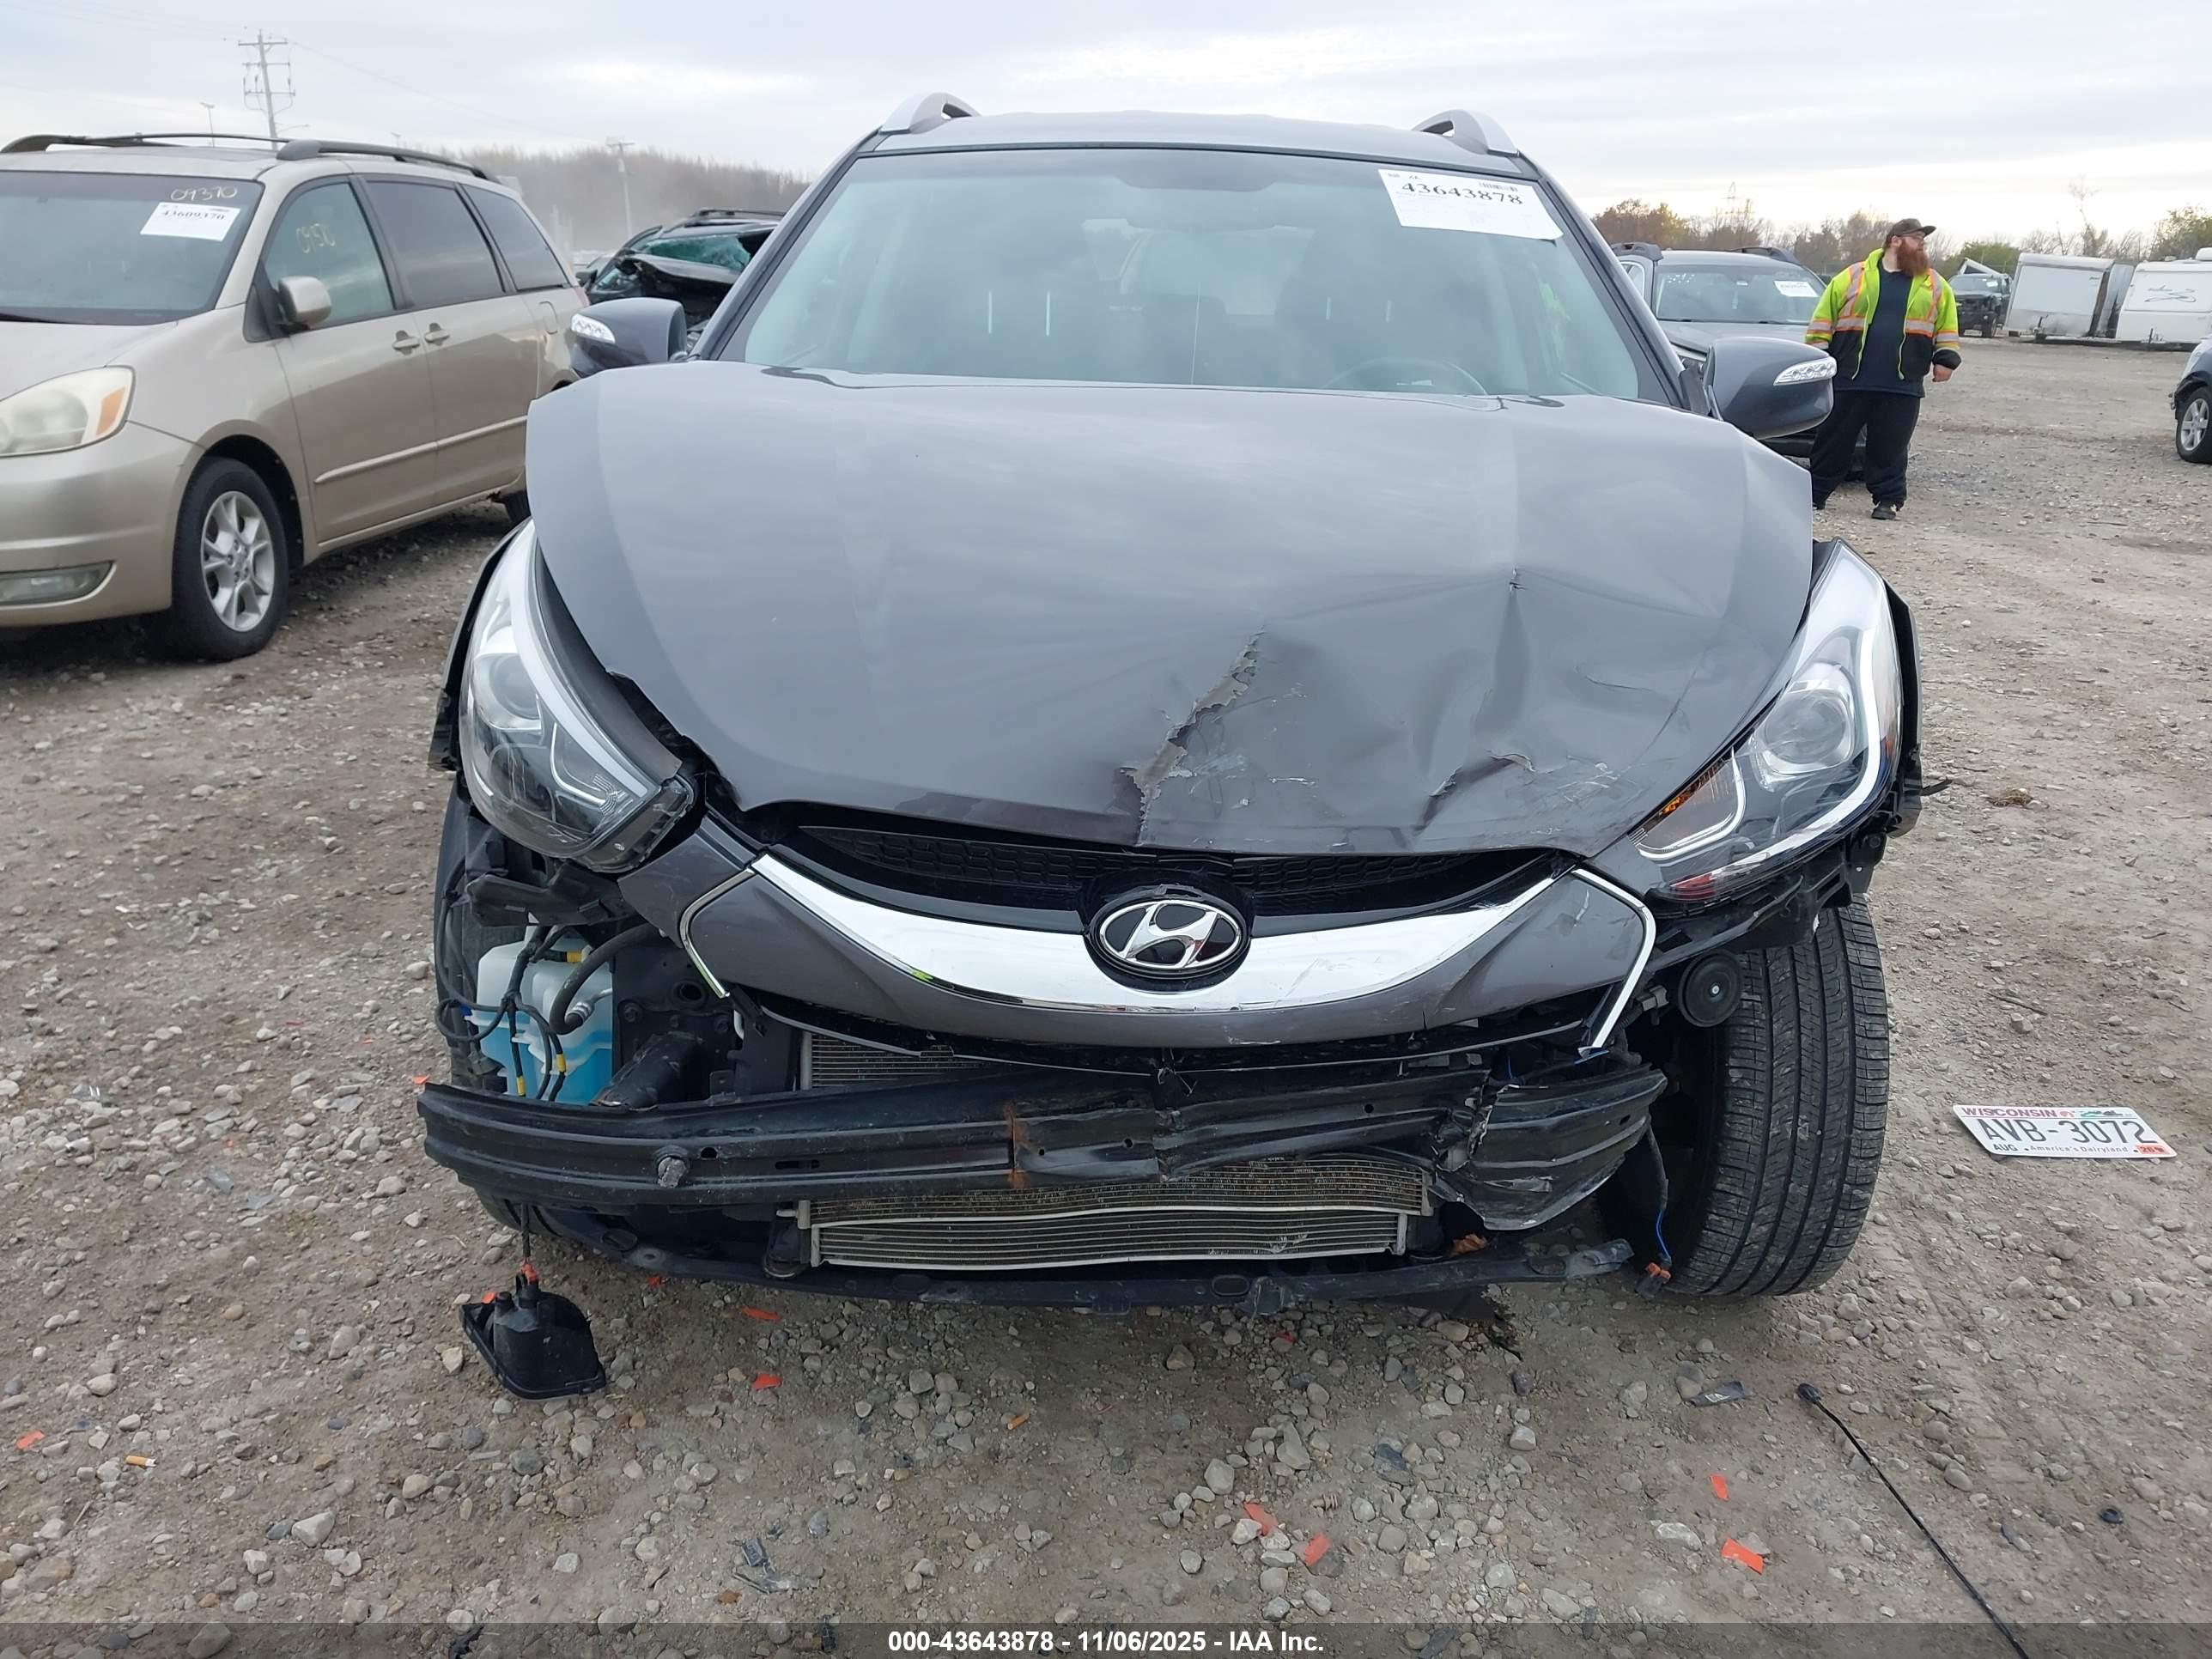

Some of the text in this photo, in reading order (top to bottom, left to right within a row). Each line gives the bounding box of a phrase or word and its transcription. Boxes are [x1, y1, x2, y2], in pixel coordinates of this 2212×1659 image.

[1401, 182, 1523, 205] 43643878
[1961, 1107, 2058, 1118] WISCONSIN
[1976, 1118, 2159, 1144] AVB-3072
[1992, 1143, 2019, 1152] AUG
[2081, 1146, 2129, 1154] Dairyland
